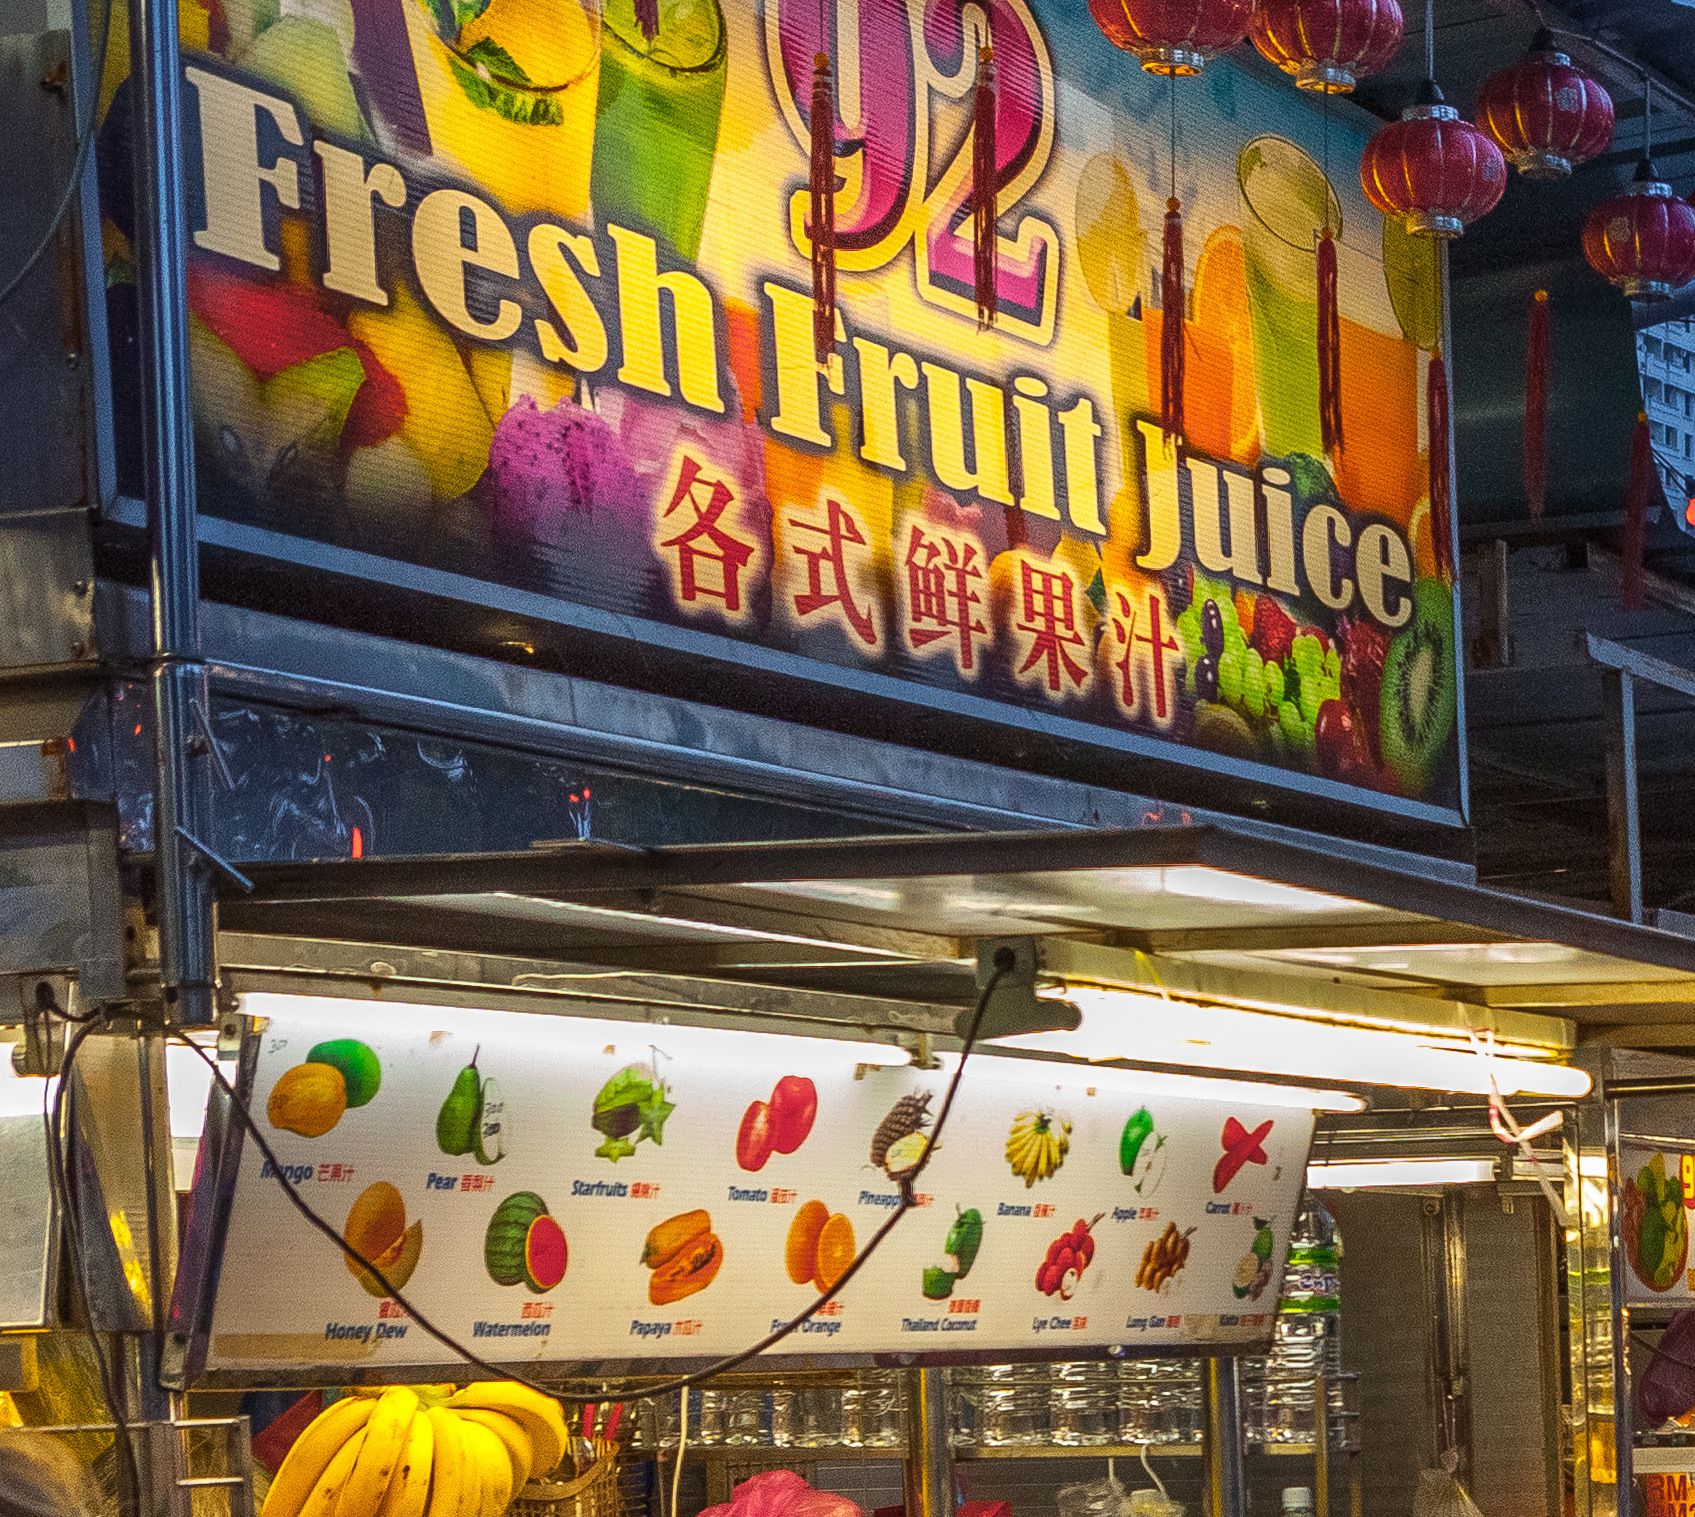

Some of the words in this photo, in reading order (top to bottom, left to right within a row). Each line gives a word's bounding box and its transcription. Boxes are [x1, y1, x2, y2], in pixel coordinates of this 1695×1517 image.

[758, 0, 1057, 348] 92
[186, 65, 726, 414] Fresh
[763, 282, 1109, 536] Fruit
[1136, 418, 1414, 628] Juice
[426, 1172, 458, 1190] Pear
[571, 1180, 628, 1197] Starfruits
[728, 1186, 768, 1202] Tomato
[997, 1203, 1032, 1217] Banana
[1111, 1206, 1137, 1221] Apple
[325, 1322, 371, 1343] Honey
[375, 1322, 408, 1339] Dew
[473, 1321, 551, 1337] Watermelon
[630, 1319, 672, 1338] Papaya
[801, 1320, 842, 1337] Orange
